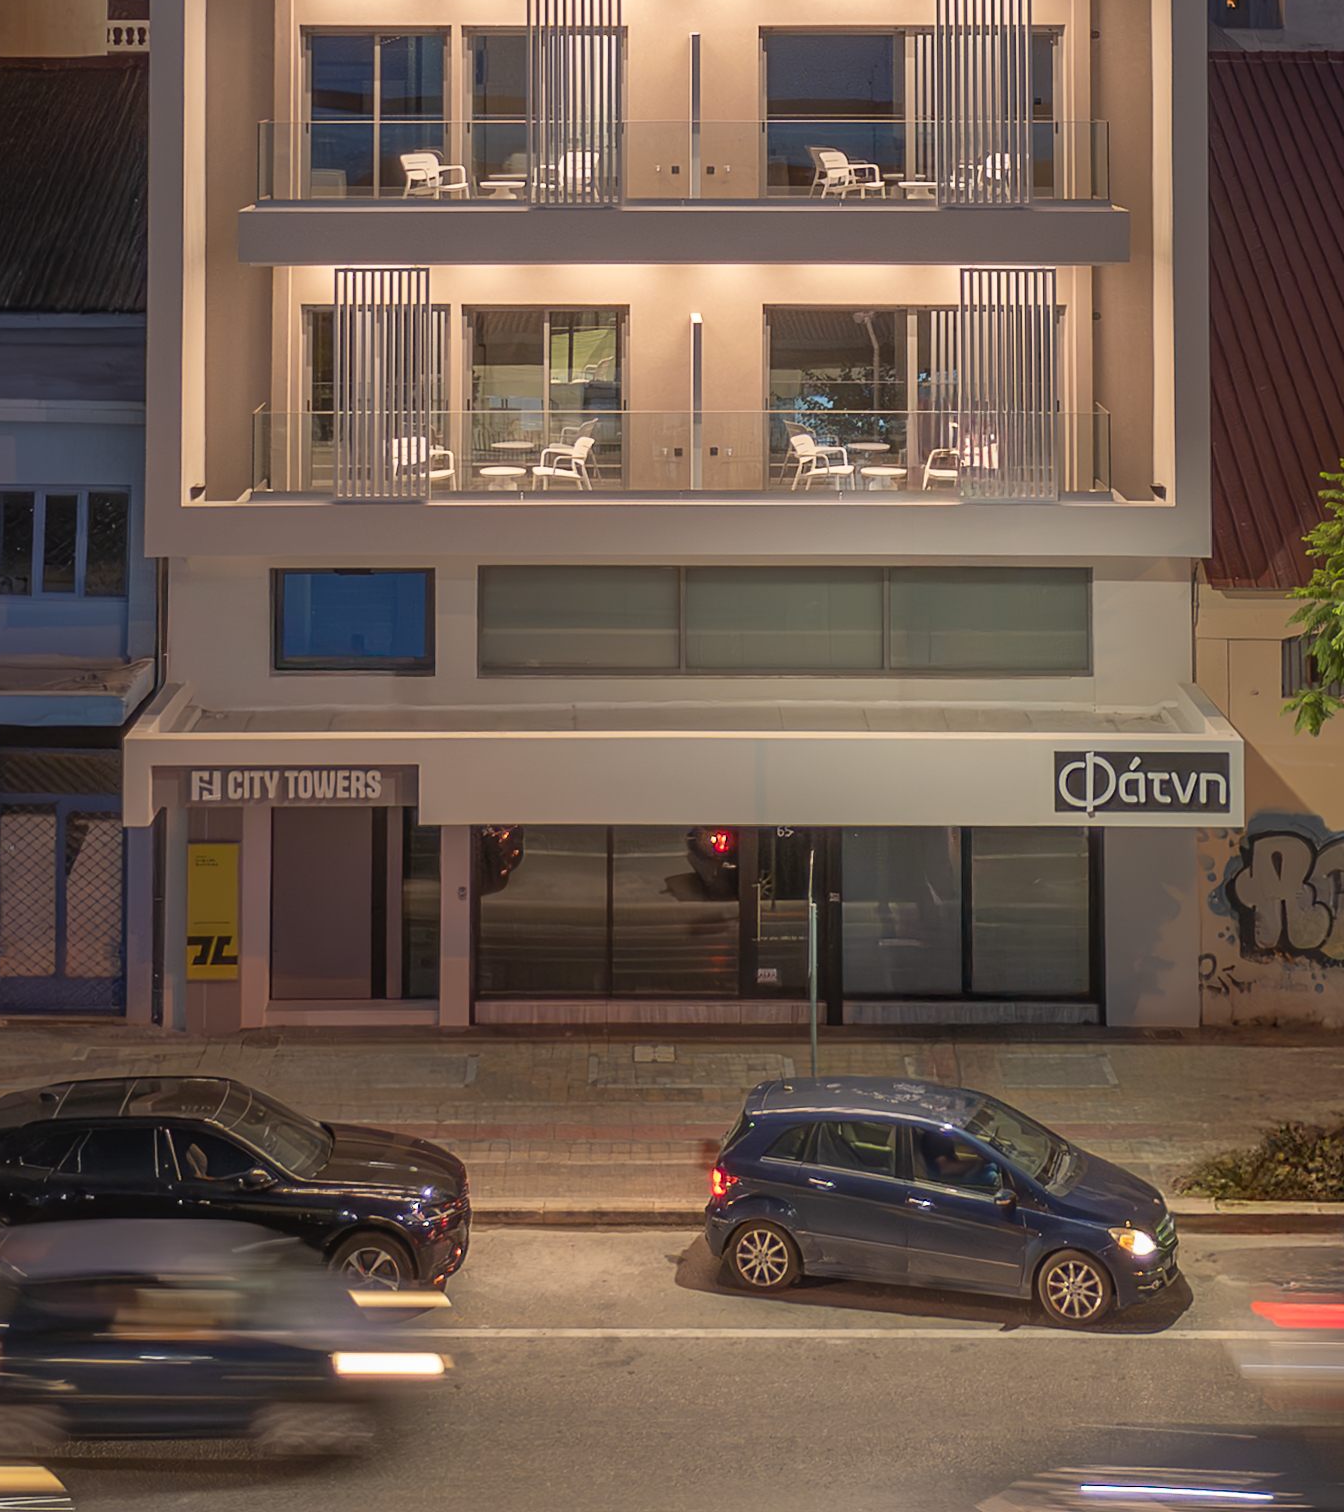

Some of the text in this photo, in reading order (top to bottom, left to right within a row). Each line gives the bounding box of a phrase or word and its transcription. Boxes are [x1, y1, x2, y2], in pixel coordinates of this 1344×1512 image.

[227, 769, 280, 800] CITY
[284, 769, 382, 799] TOWERS
[1058, 751, 1227, 813] Φάτνη
